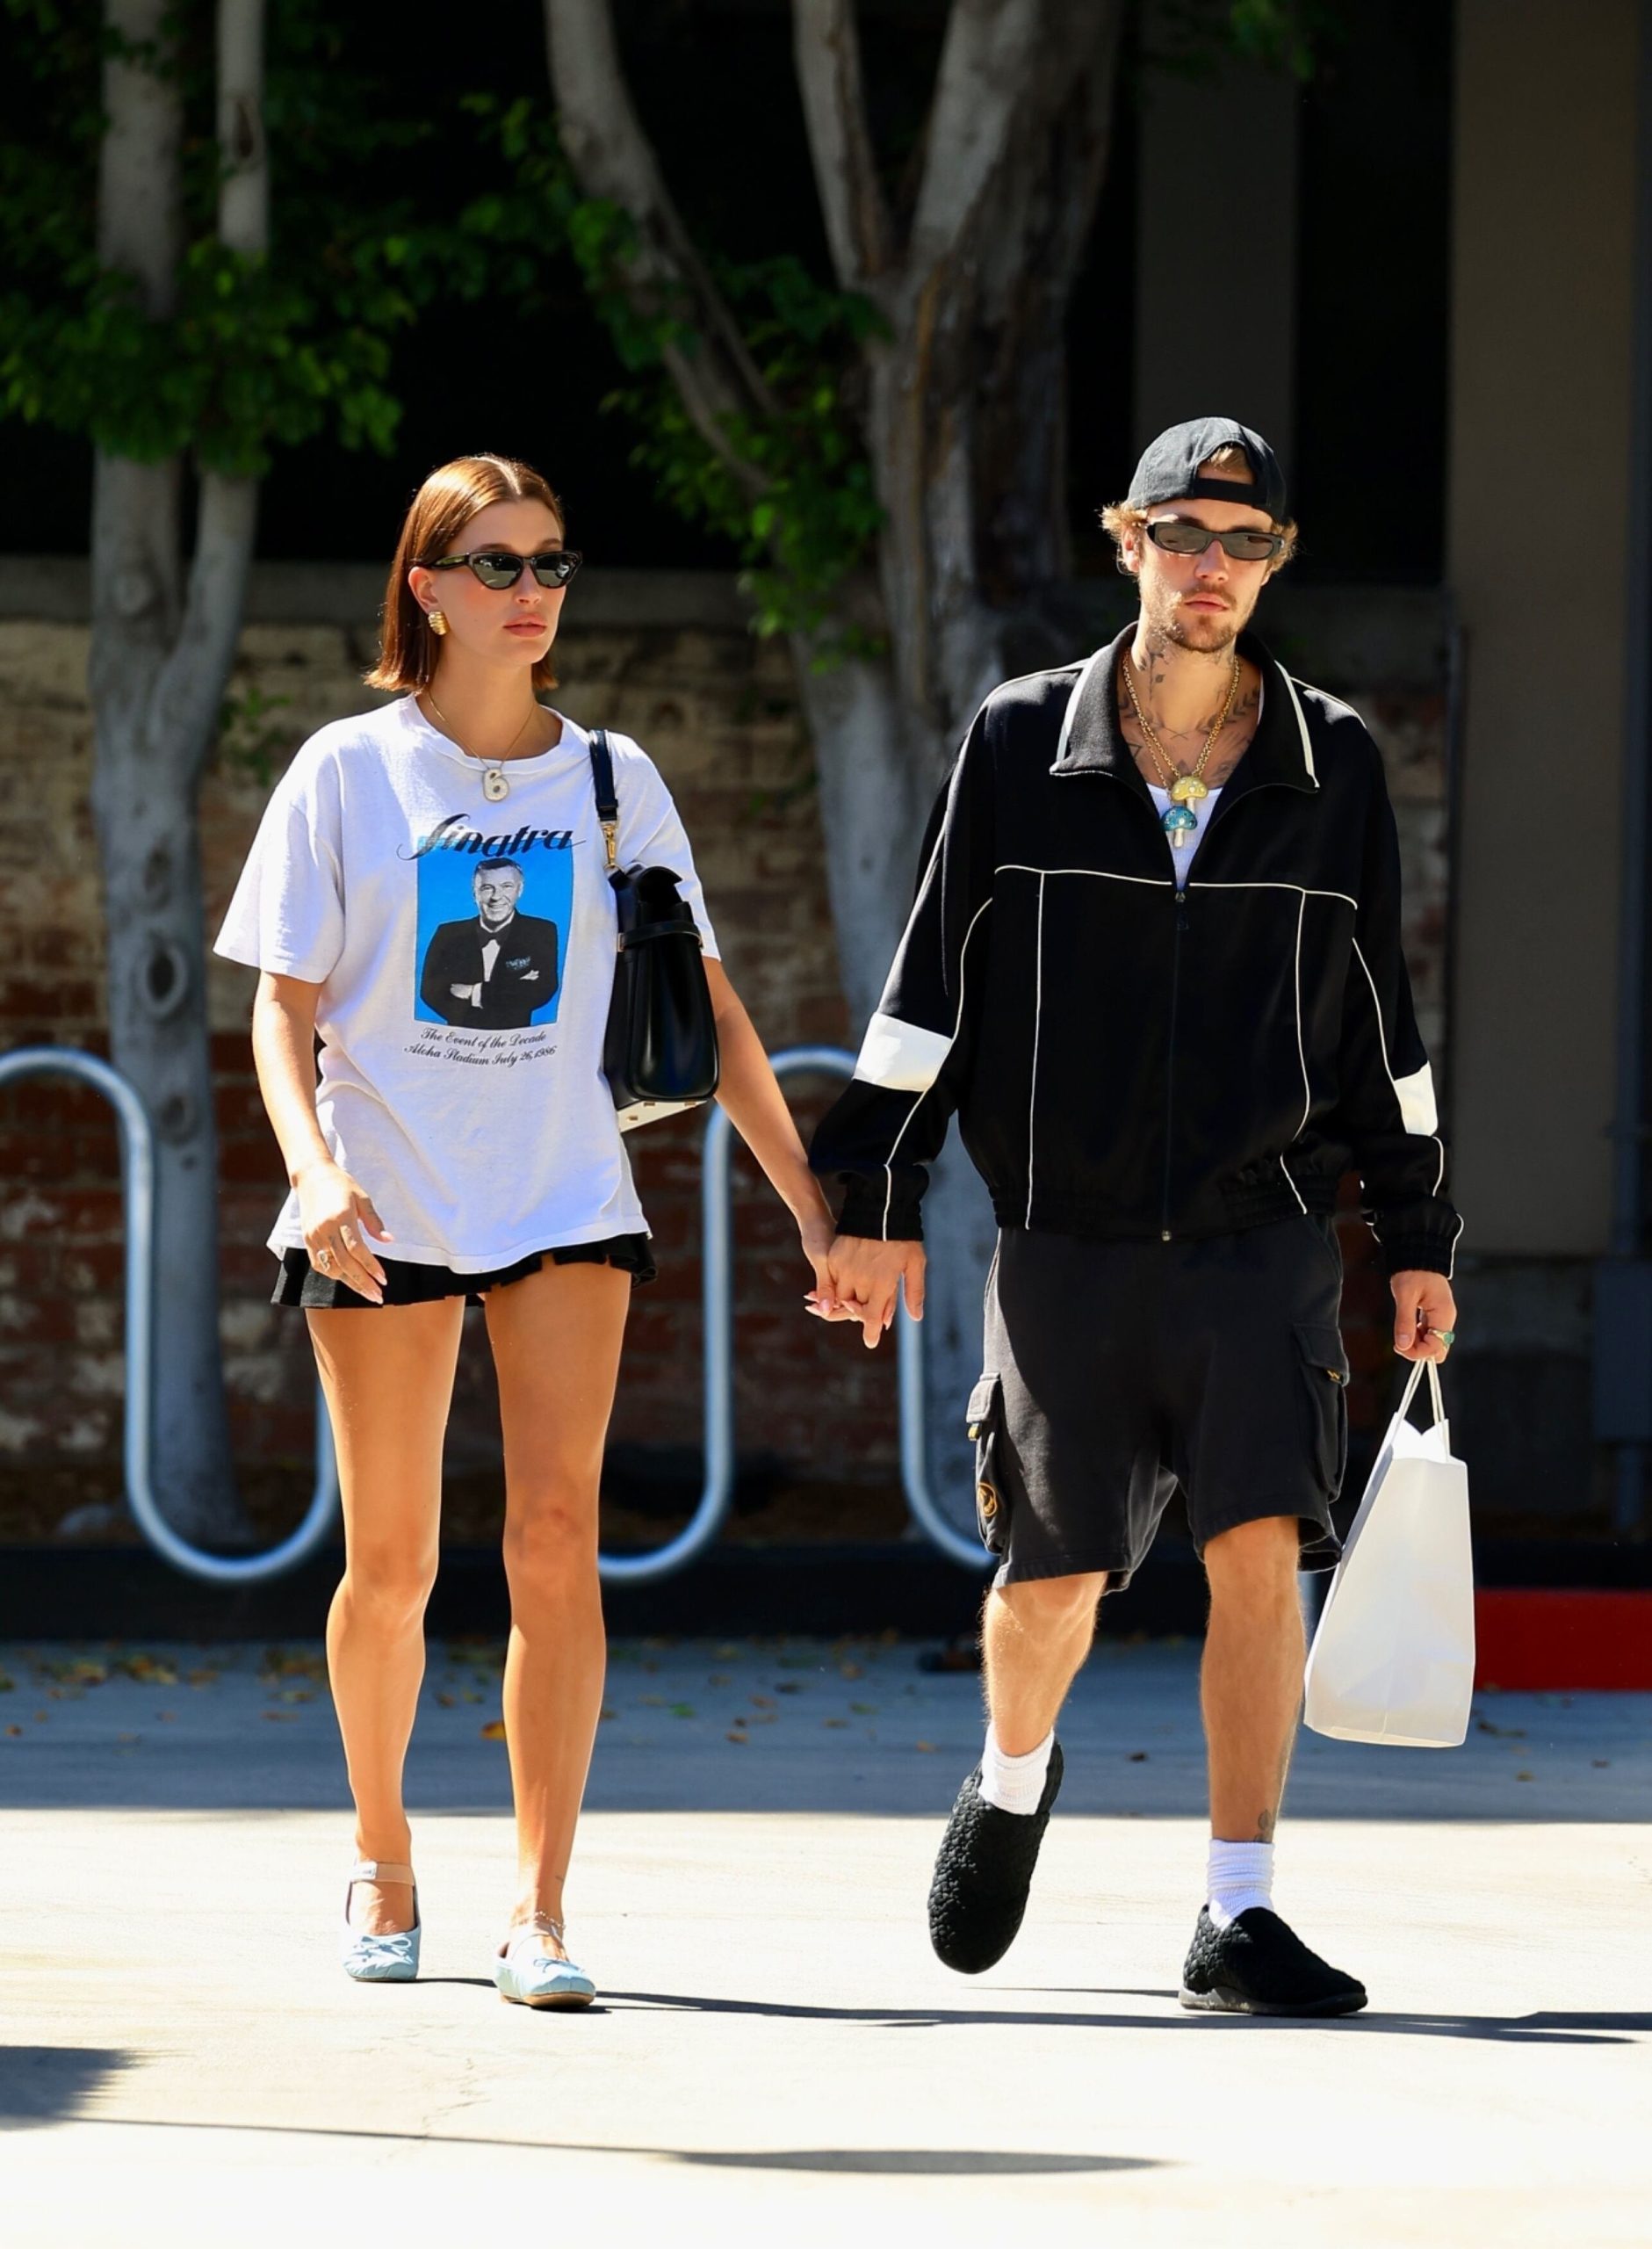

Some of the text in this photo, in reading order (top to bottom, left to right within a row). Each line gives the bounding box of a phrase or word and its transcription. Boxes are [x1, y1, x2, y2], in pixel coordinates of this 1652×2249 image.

[396, 814, 587, 860] Sinatra
[421, 1027, 546, 1053] The Event of the Decade
[404, 1043, 441, 1058] Aloha
[444, 1048, 489, 1065] Stadium
[492, 1051, 518, 1068] July
